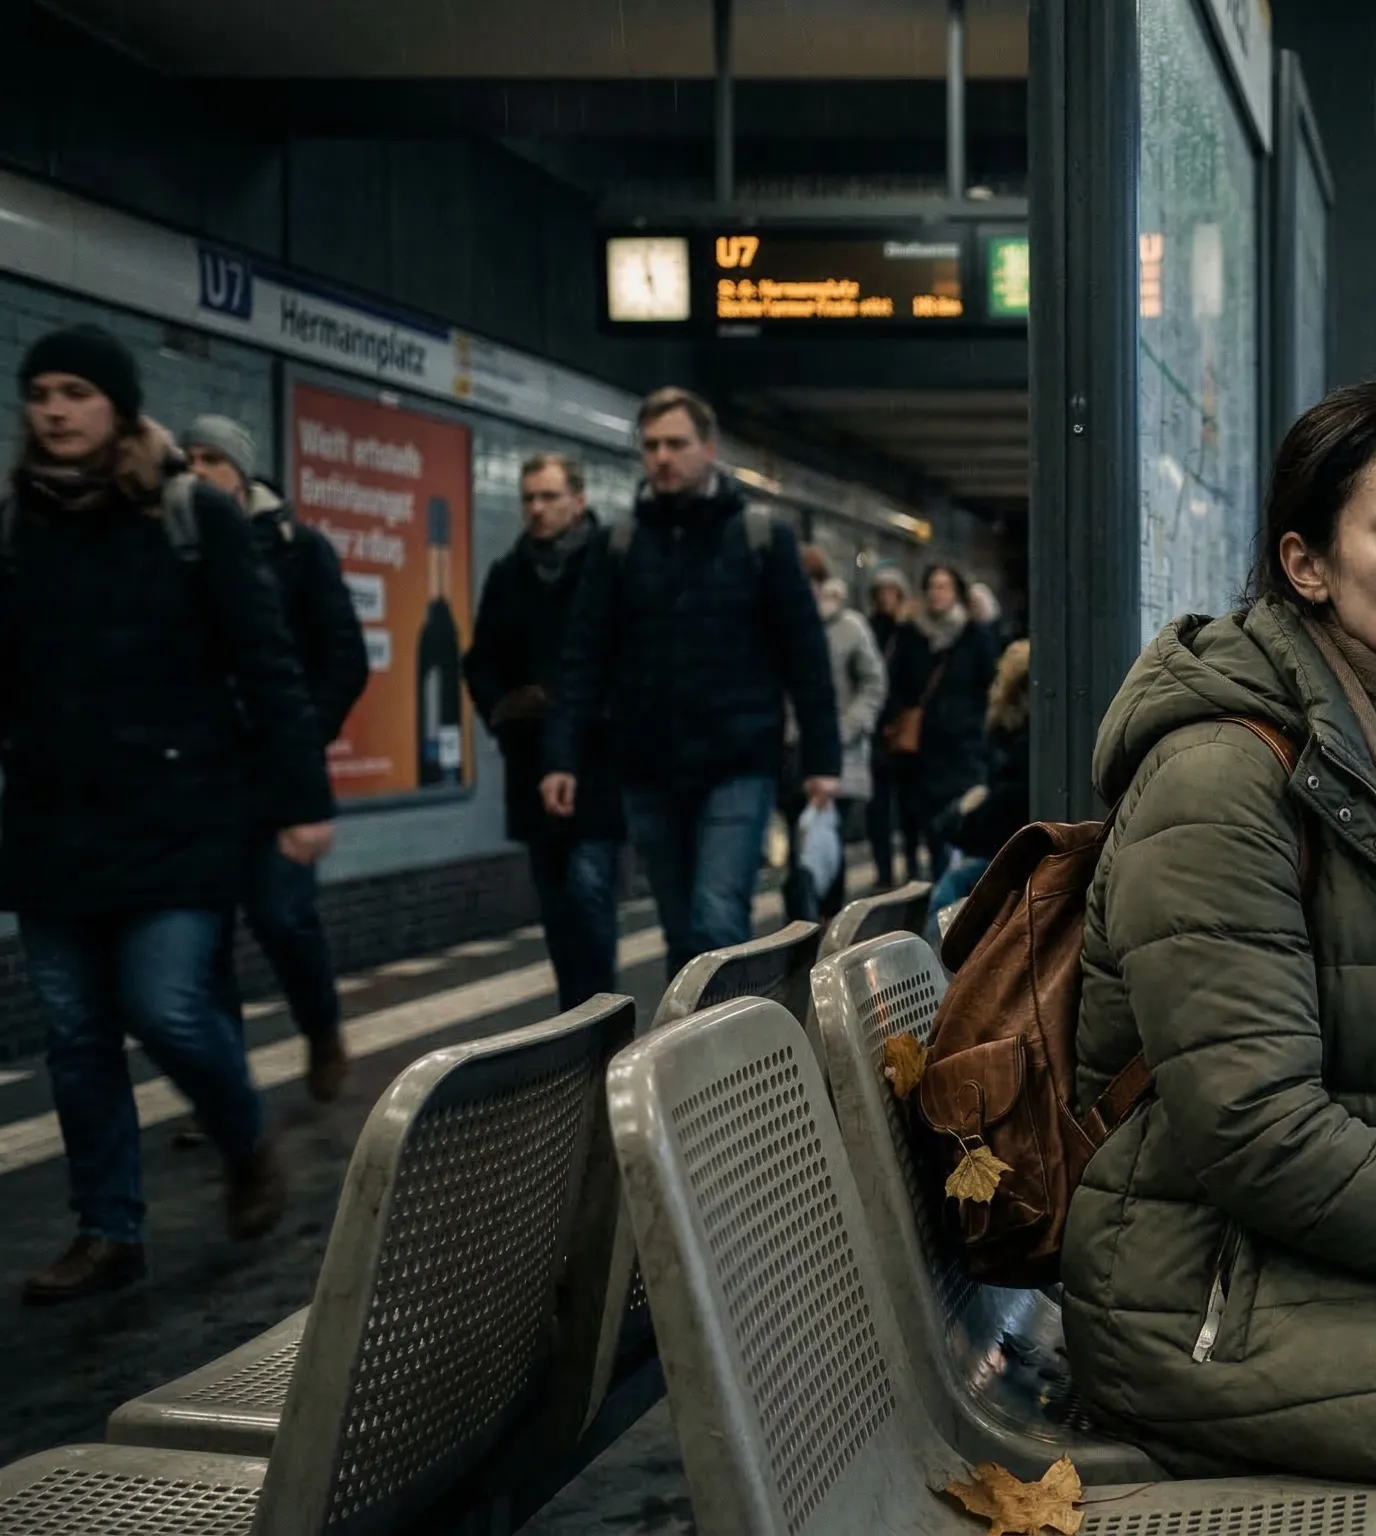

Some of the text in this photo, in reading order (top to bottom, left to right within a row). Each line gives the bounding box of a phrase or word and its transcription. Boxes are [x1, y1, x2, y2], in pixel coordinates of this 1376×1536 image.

[715, 235, 760, 268] U7
[204, 252, 245, 312] U7
[279, 293, 428, 377] Hermannplatz
